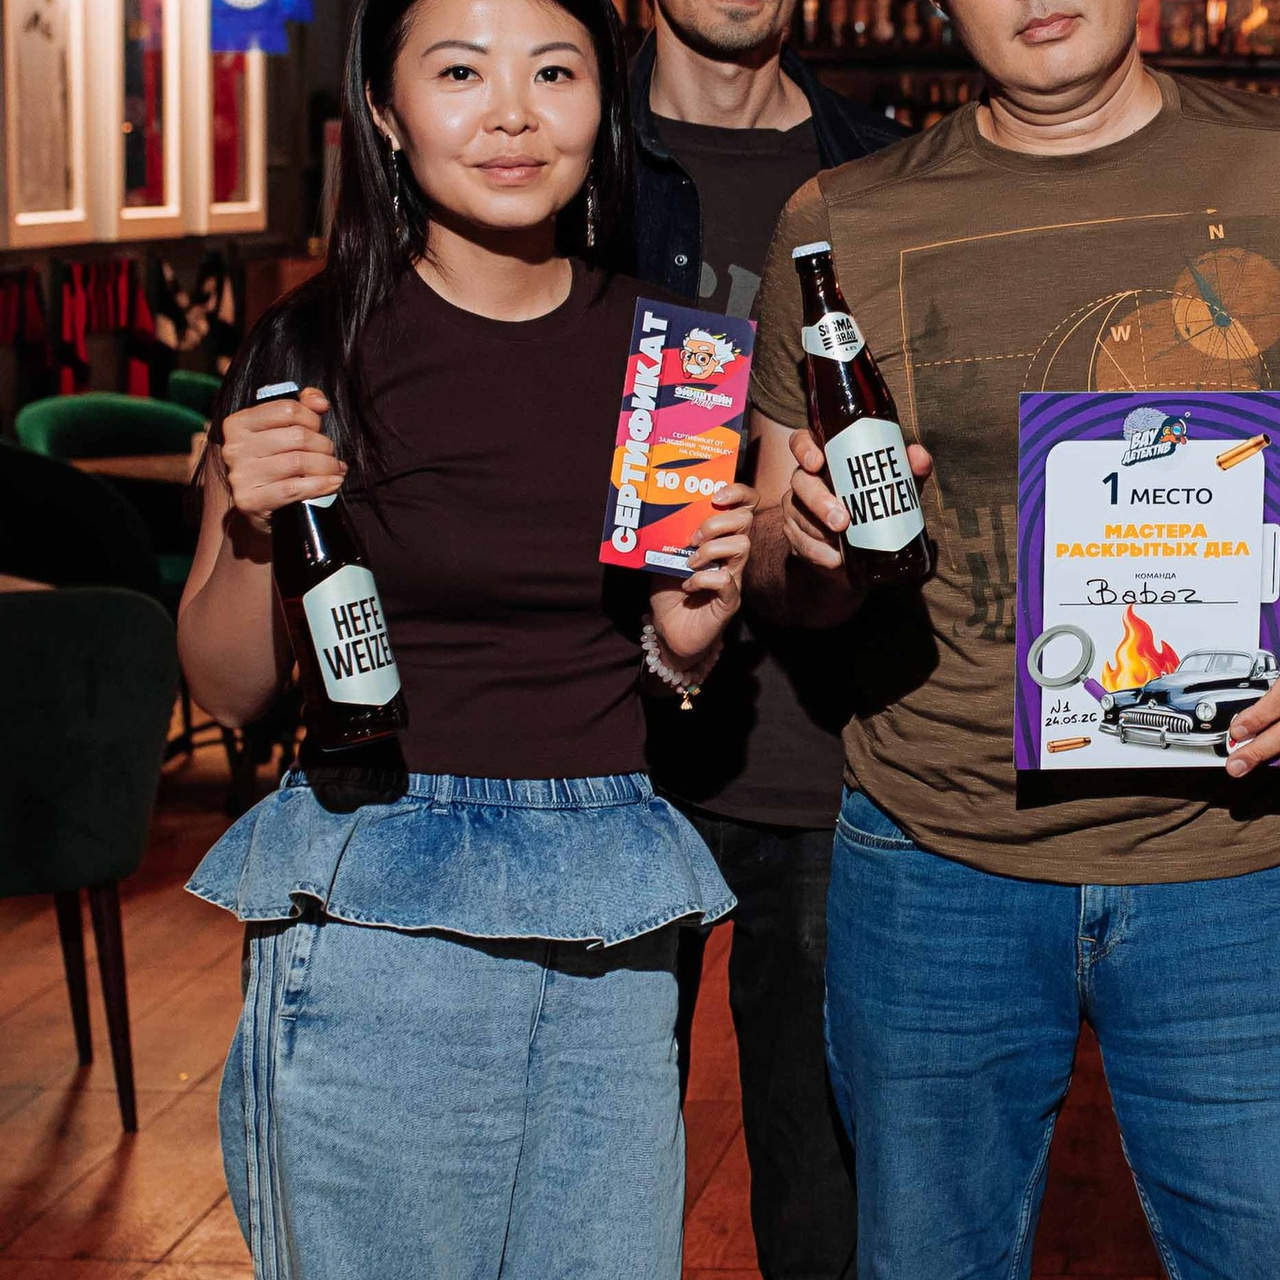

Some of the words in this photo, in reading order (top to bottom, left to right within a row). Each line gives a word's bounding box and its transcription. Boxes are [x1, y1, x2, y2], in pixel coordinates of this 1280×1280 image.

[1208, 224, 1225, 240] N
[1110, 324, 1132, 343] W
[611, 311, 668, 553] СЕРТИФИКАТ
[672, 431, 714, 444] СЕРТИФИКАТ
[714, 439, 724, 447] ОТ
[658, 436, 696, 449] ЗАВЕДЕНИЯ
[1122, 441, 1171, 466] ДЕТЕКТИВ
[846, 446, 902, 490] HEFE
[655, 469, 680, 490] 10
[1102, 472, 1119, 505] 1
[1130, 487, 1213, 505] МЕСТО
[841, 477, 919, 527] WEIZEN
[1104, 523, 1208, 539] МАСТЕРА
[1055, 542, 1199, 558] РАСКРЫТЫХ
[1203, 541, 1250, 559] ДЕЛ
[1134, 572, 1177, 580] КОМАНДА
[331, 596, 383, 641] HEFE
[1045, 712, 1098, 727] 24.05.26
